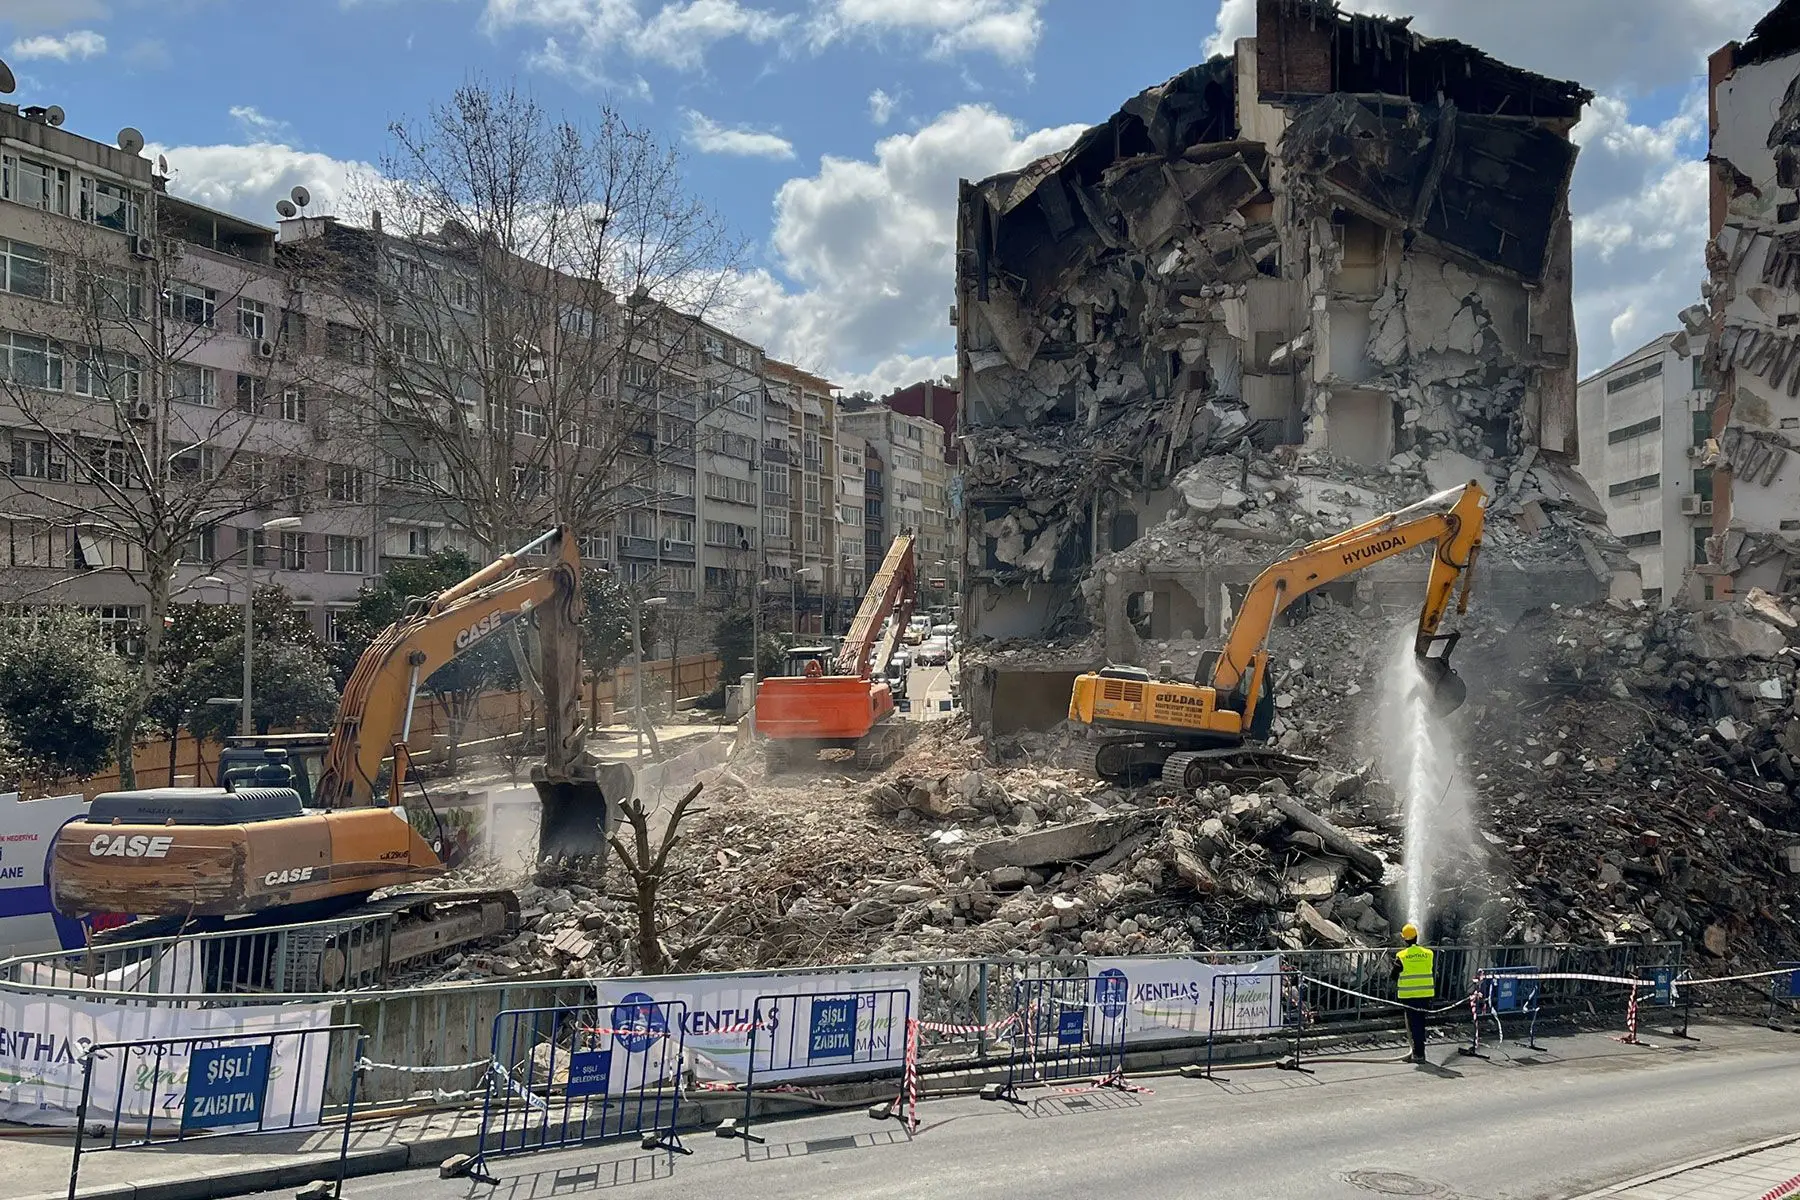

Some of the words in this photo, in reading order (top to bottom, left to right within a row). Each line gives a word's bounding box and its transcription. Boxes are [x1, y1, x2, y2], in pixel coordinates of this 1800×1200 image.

[1342, 535, 1407, 565] HYUNDAI
[456, 608, 501, 649] CASE
[89, 833, 174, 858] CASE
[264, 866, 313, 886] CASE
[1134, 982, 1199, 1005] KENTHAŞ
[678, 1007, 779, 1038] KENTHAŞ
[821, 1004, 847, 1027] ŞİŞLİ
[813, 1033, 850, 1051] ZABITA
[207, 1052, 252, 1085] ŞİŞLİ
[571, 1073, 607, 1084] BELEDİYESİ
[582, 1064, 598, 1074] ŞİŞLİ
[191, 1092, 255, 1118] ZABITA
